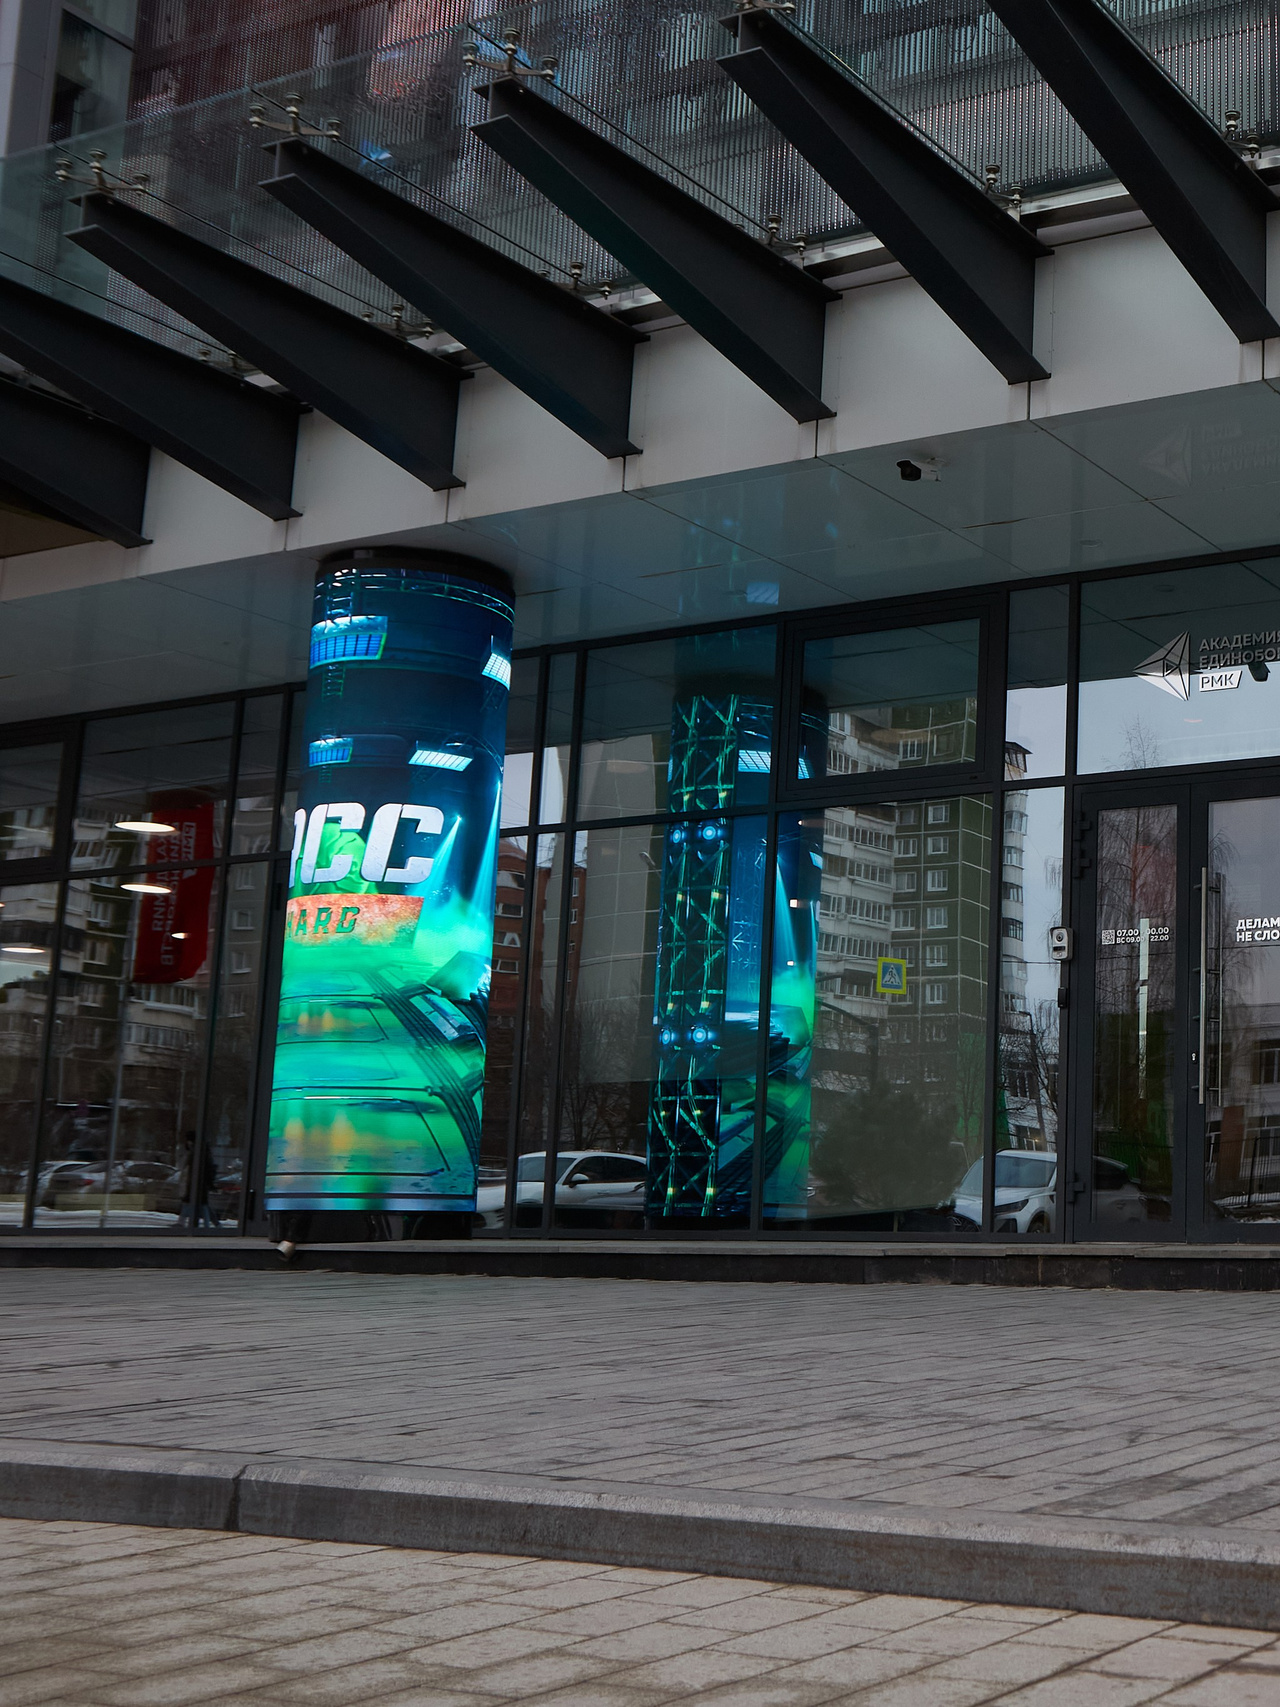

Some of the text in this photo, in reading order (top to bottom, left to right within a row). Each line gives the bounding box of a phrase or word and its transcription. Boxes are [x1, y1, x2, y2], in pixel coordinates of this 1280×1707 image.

[1201, 673, 1236, 689] РМК
[288, 802, 445, 889] CC
[1116, 928, 1139, 937] 07.00
[1150, 934, 1170, 942] 22.00
[1236, 931, 1253, 942] НЕ
